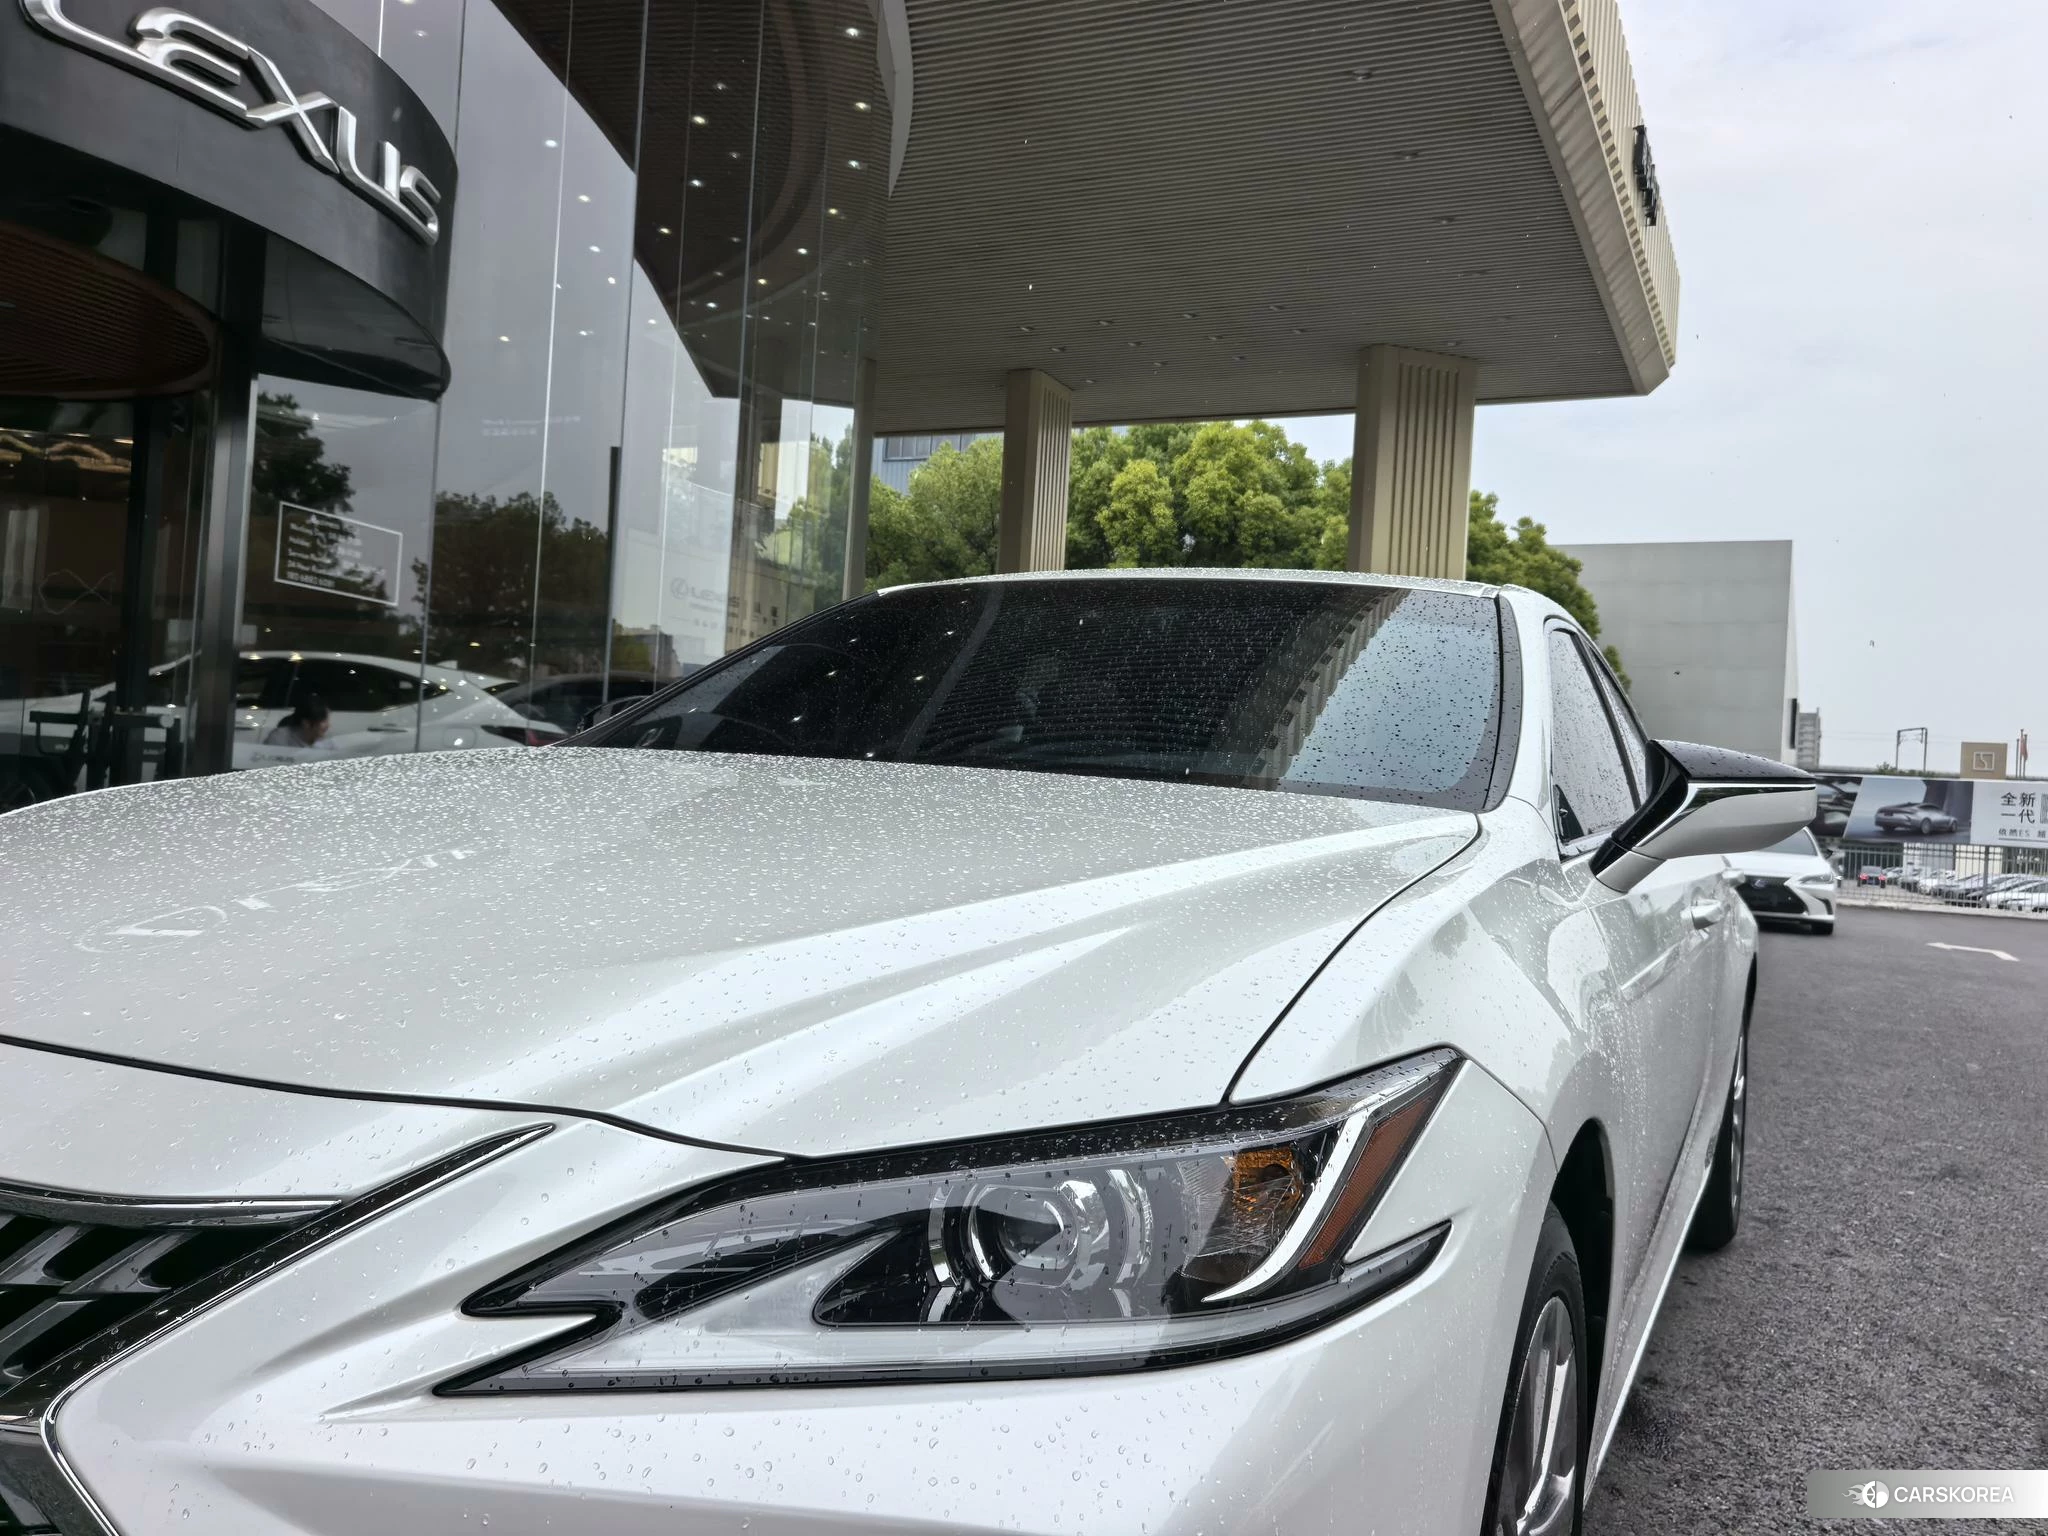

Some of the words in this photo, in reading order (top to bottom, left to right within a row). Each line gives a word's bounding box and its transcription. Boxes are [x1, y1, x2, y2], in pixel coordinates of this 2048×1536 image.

[20, 0, 443, 246] LEXUS
[2000, 791, 2036, 808] 全新
[2000, 808, 2036, 824] 一代
